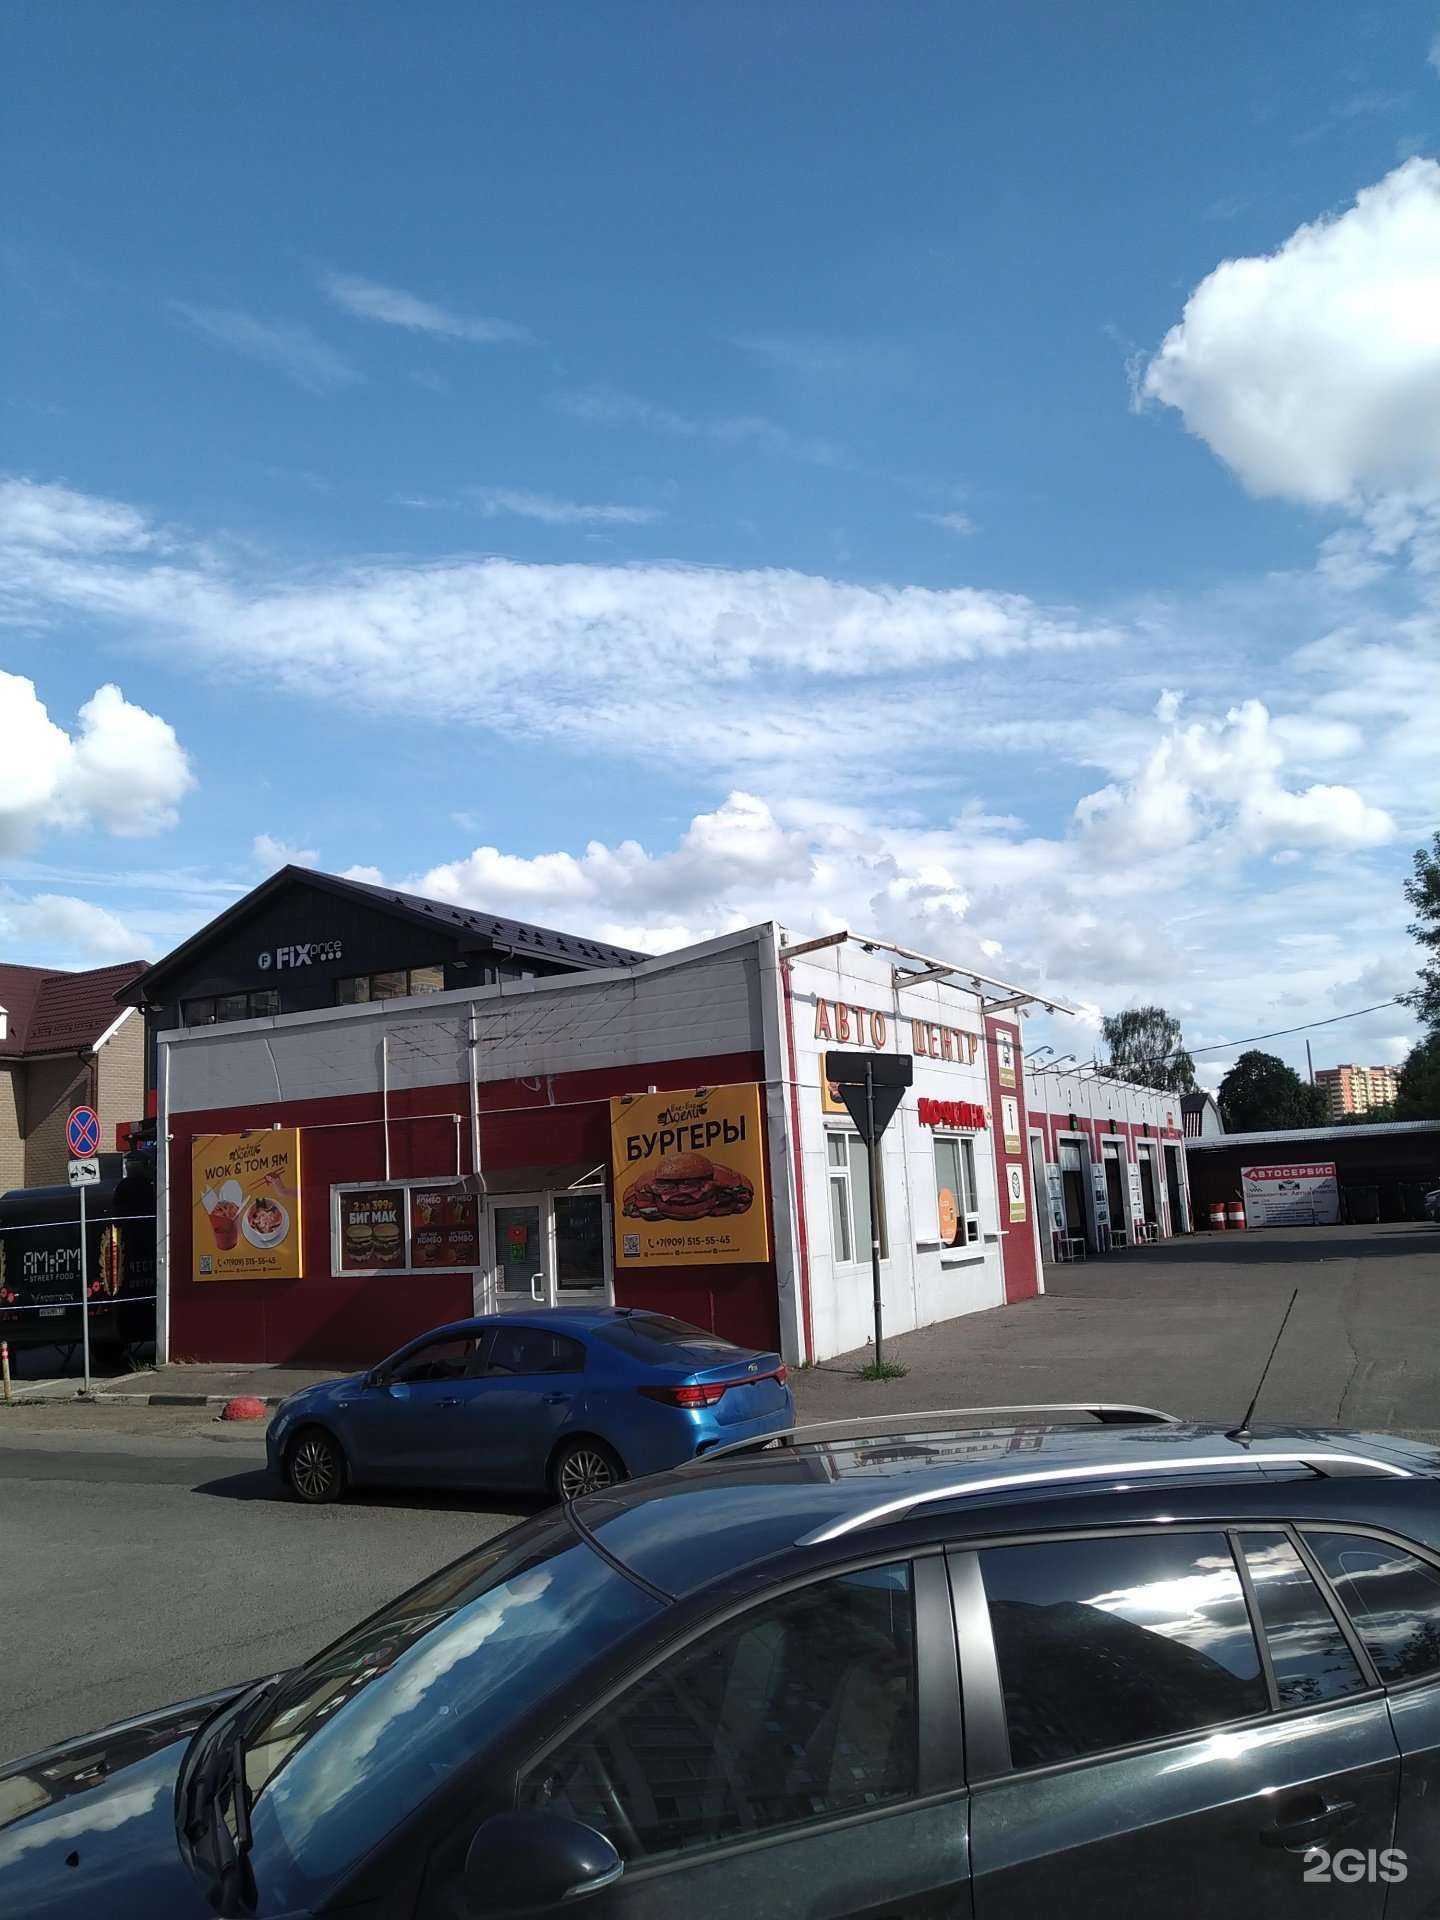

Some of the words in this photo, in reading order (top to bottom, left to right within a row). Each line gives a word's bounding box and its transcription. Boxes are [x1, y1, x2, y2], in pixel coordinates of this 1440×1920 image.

[310, 940, 342, 957] price
[814, 997, 887, 1050] АВТО
[911, 1018, 978, 1066] ЦЕНТР
[626, 1115, 746, 1162] БУРГЕРЫ
[205, 1164, 231, 1180] WOK
[234, 1161, 242, 1175] &
[271, 1152, 289, 1168] ЯМ
[1249, 1166, 1334, 1179] АВТОСЕРВИС
[349, 1212, 370, 1225] БИГ
[371, 1210, 397, 1223] МАК
[687, 1235, 731, 1246] 515-55-45
[29, 1274, 54, 1283] STREET
[55, 1272, 74, 1281] FOOD
